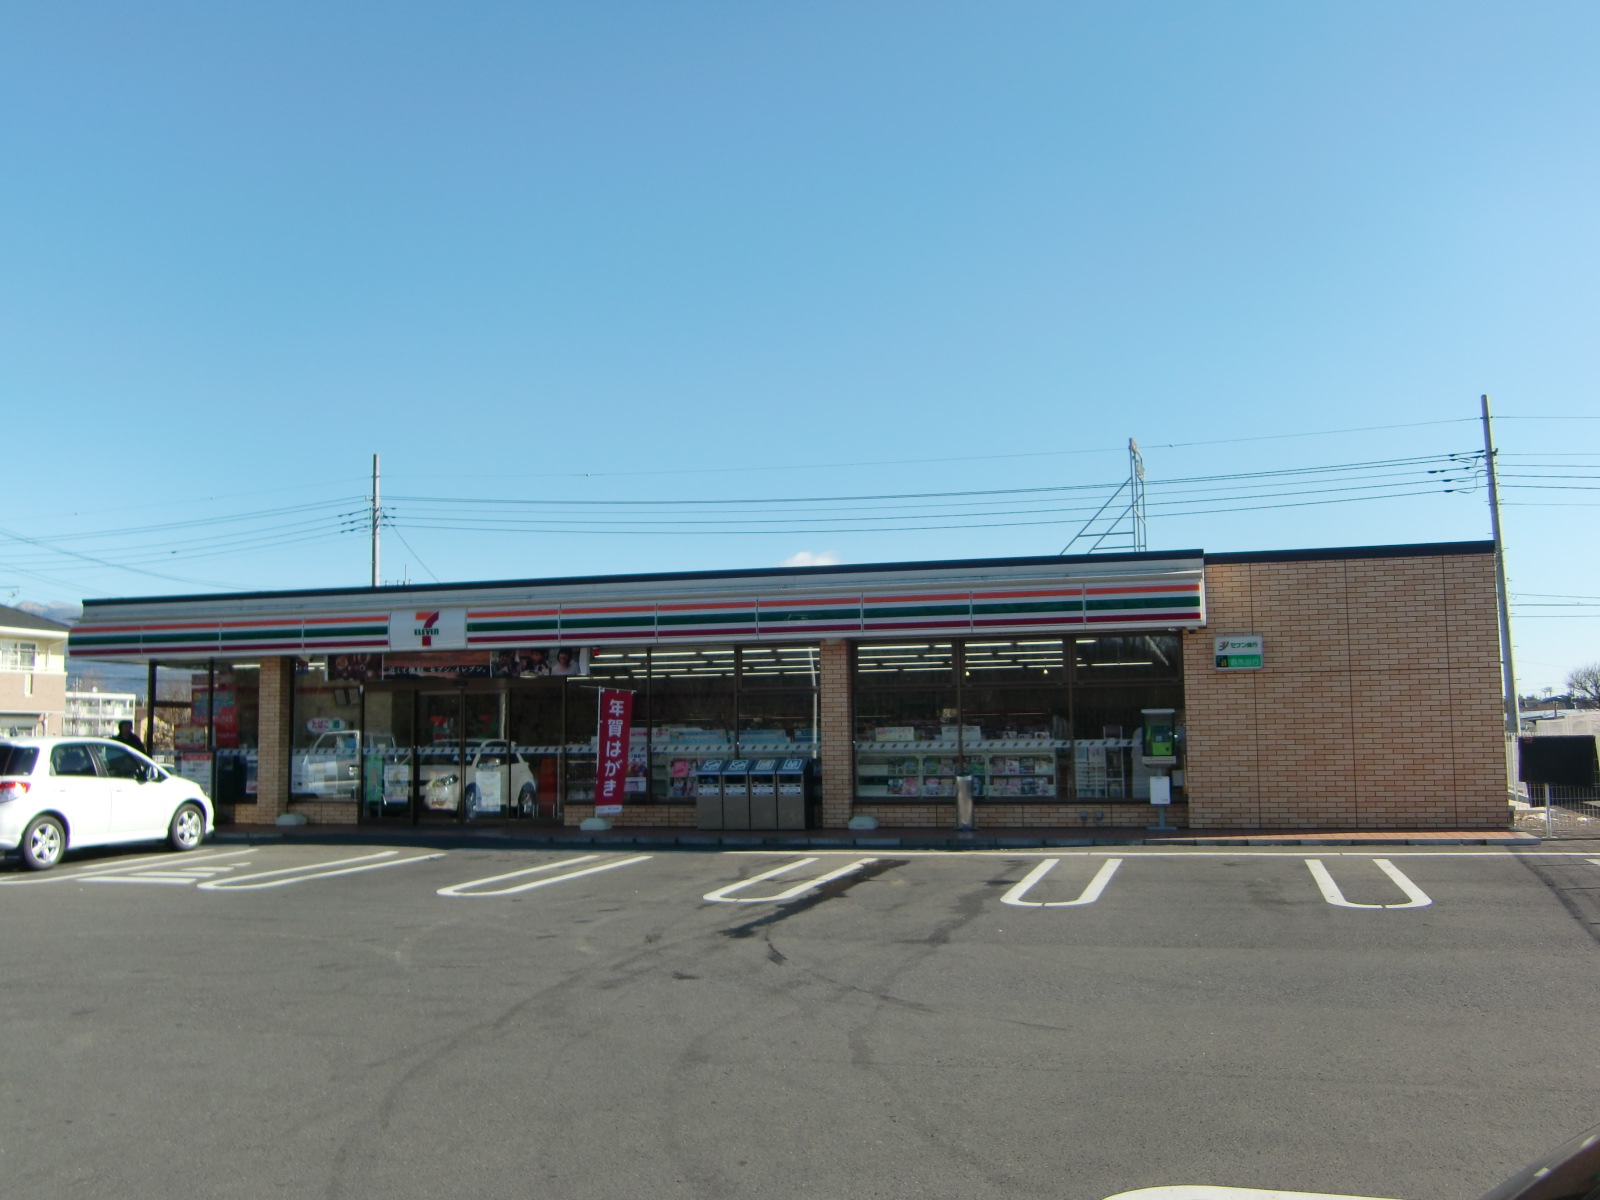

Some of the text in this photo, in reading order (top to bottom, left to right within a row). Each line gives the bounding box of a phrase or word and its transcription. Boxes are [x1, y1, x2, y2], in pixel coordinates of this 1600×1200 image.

[602, 698, 625, 797] 年賀はがき
